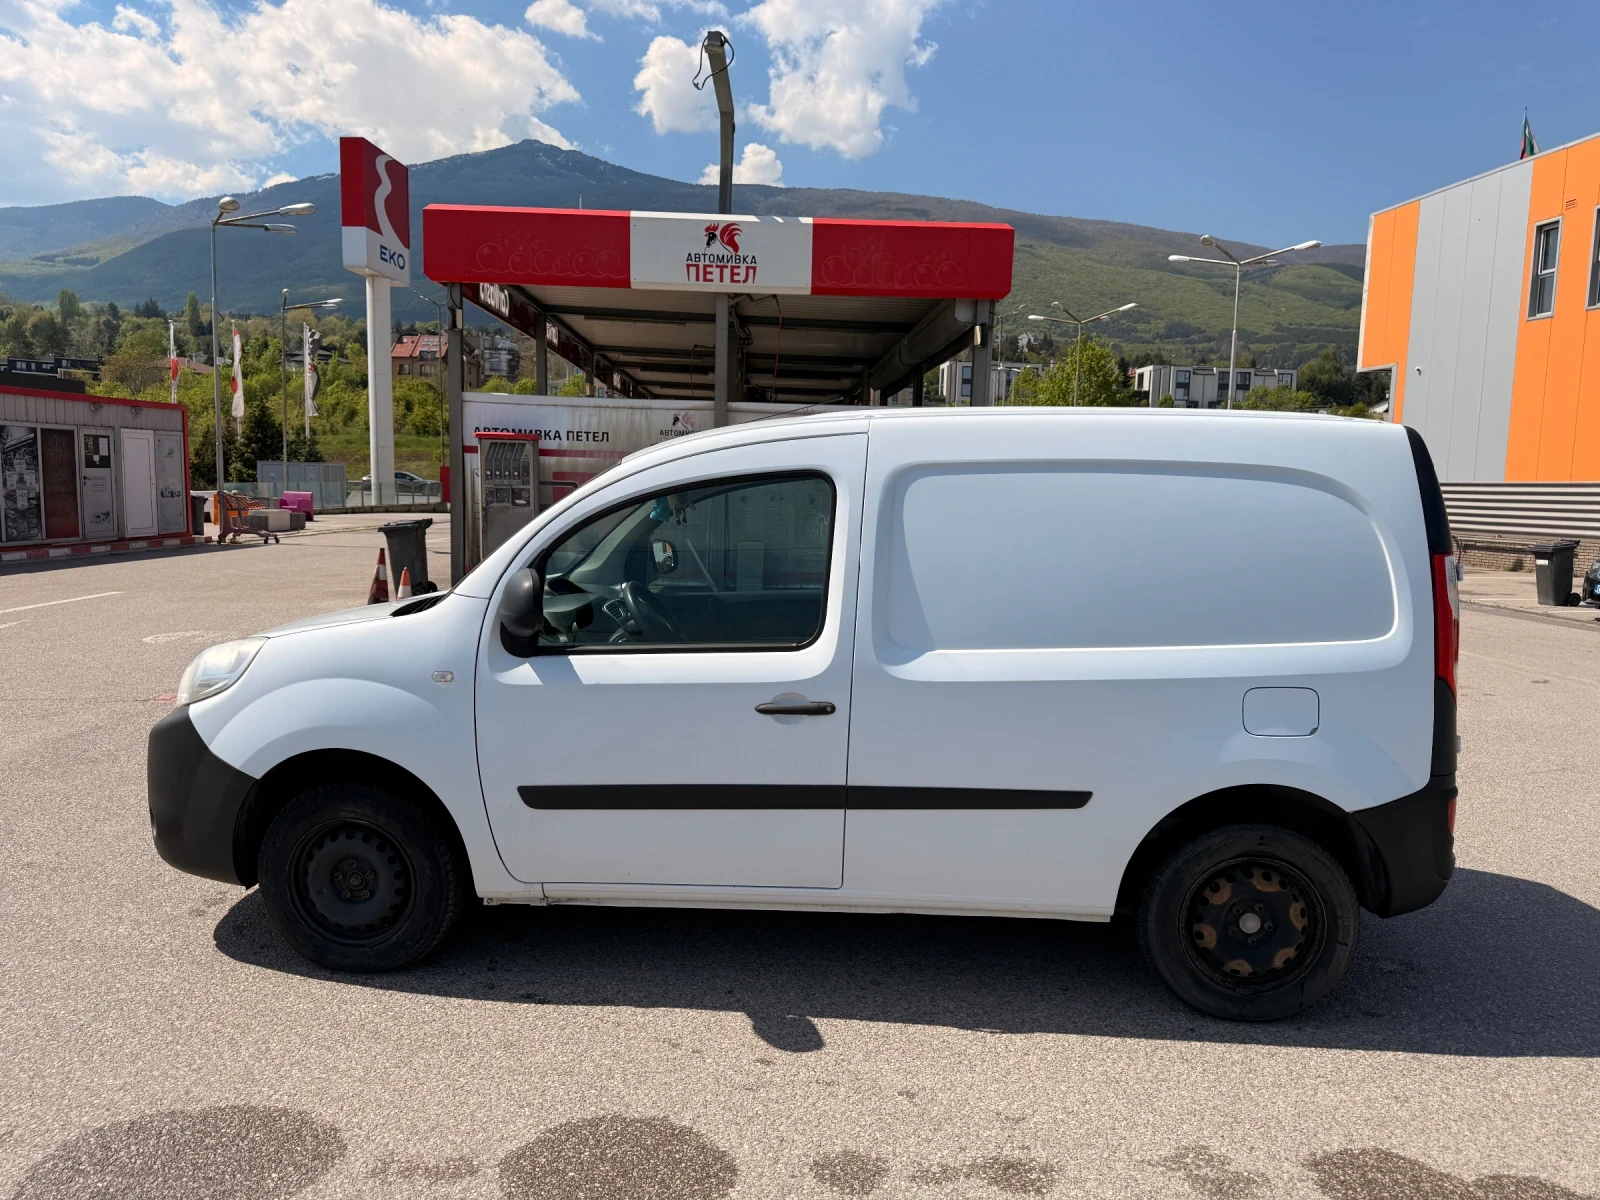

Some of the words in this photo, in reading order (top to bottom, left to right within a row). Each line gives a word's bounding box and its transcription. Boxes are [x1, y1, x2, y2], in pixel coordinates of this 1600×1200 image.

[686, 252, 758, 265] АВТОМИВКА
[686, 263, 757, 284] ПЕТЕЛ
[566, 430, 610, 443] ПЕТЕЛ
